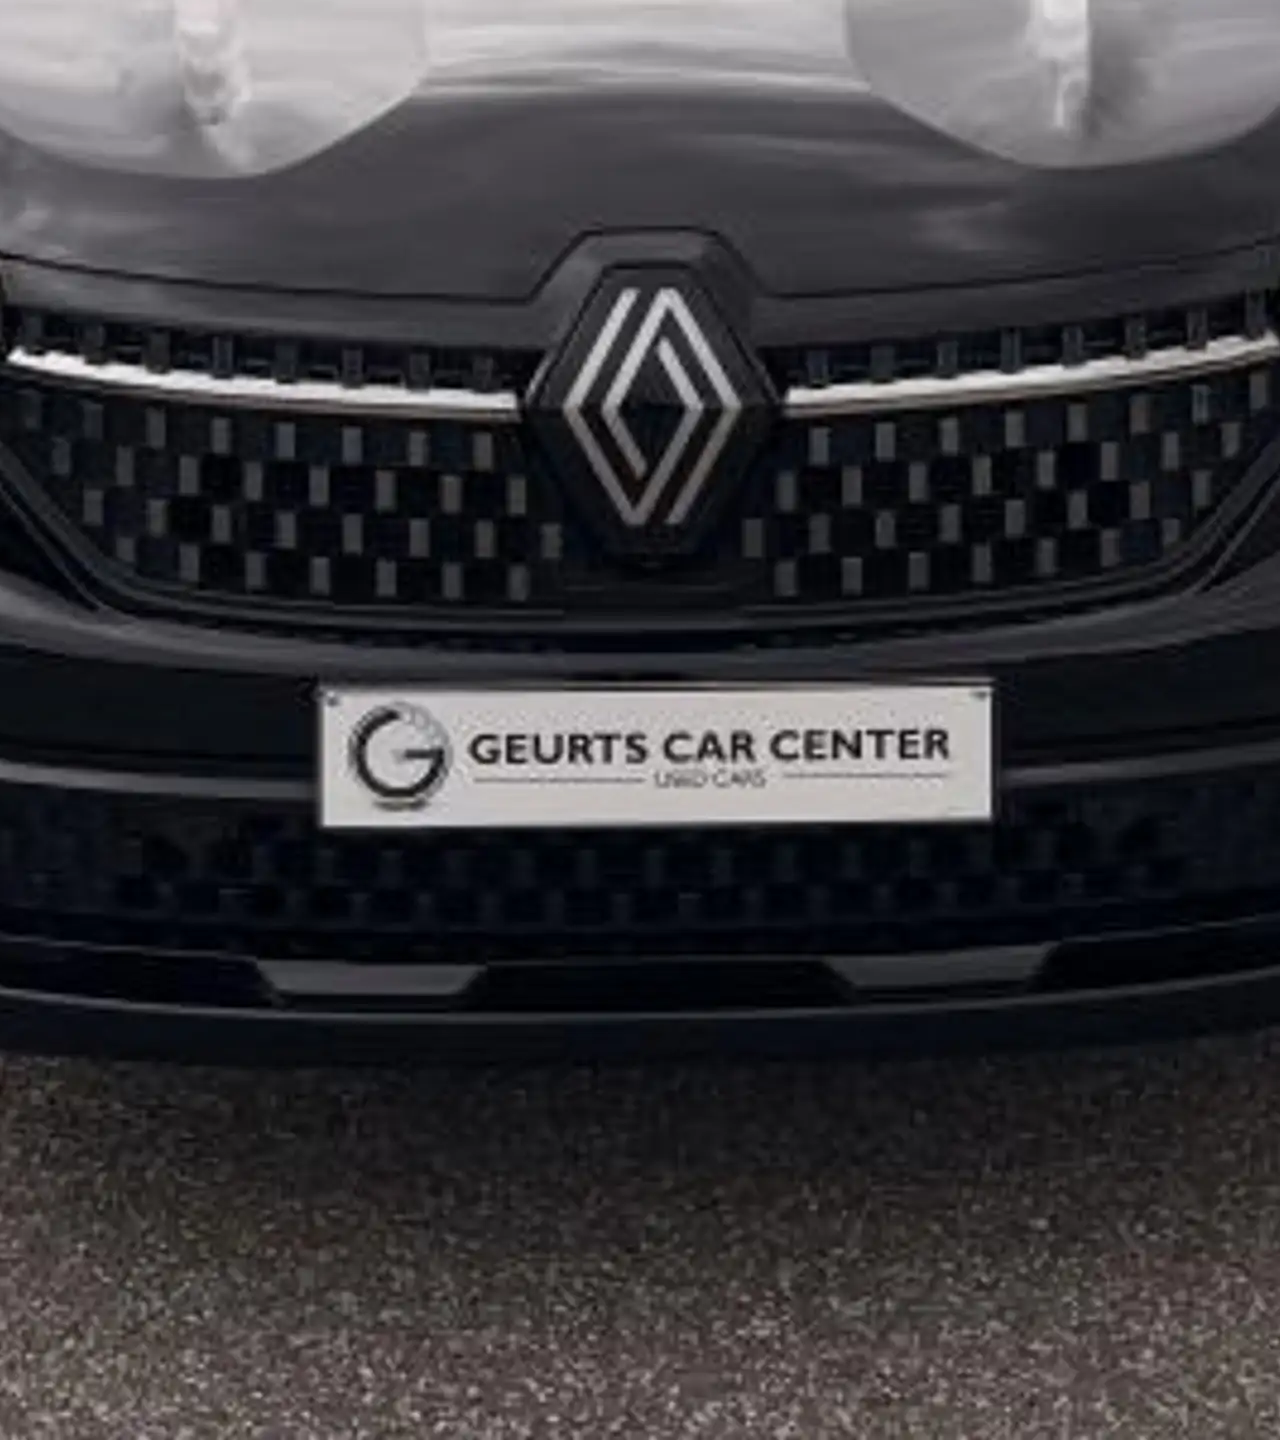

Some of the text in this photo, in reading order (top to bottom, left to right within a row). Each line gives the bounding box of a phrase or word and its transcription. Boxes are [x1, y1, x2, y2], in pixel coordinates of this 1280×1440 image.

[467, 726, 951, 766] GEURTS CAR CENTER
[710, 766, 767, 790] CARS
